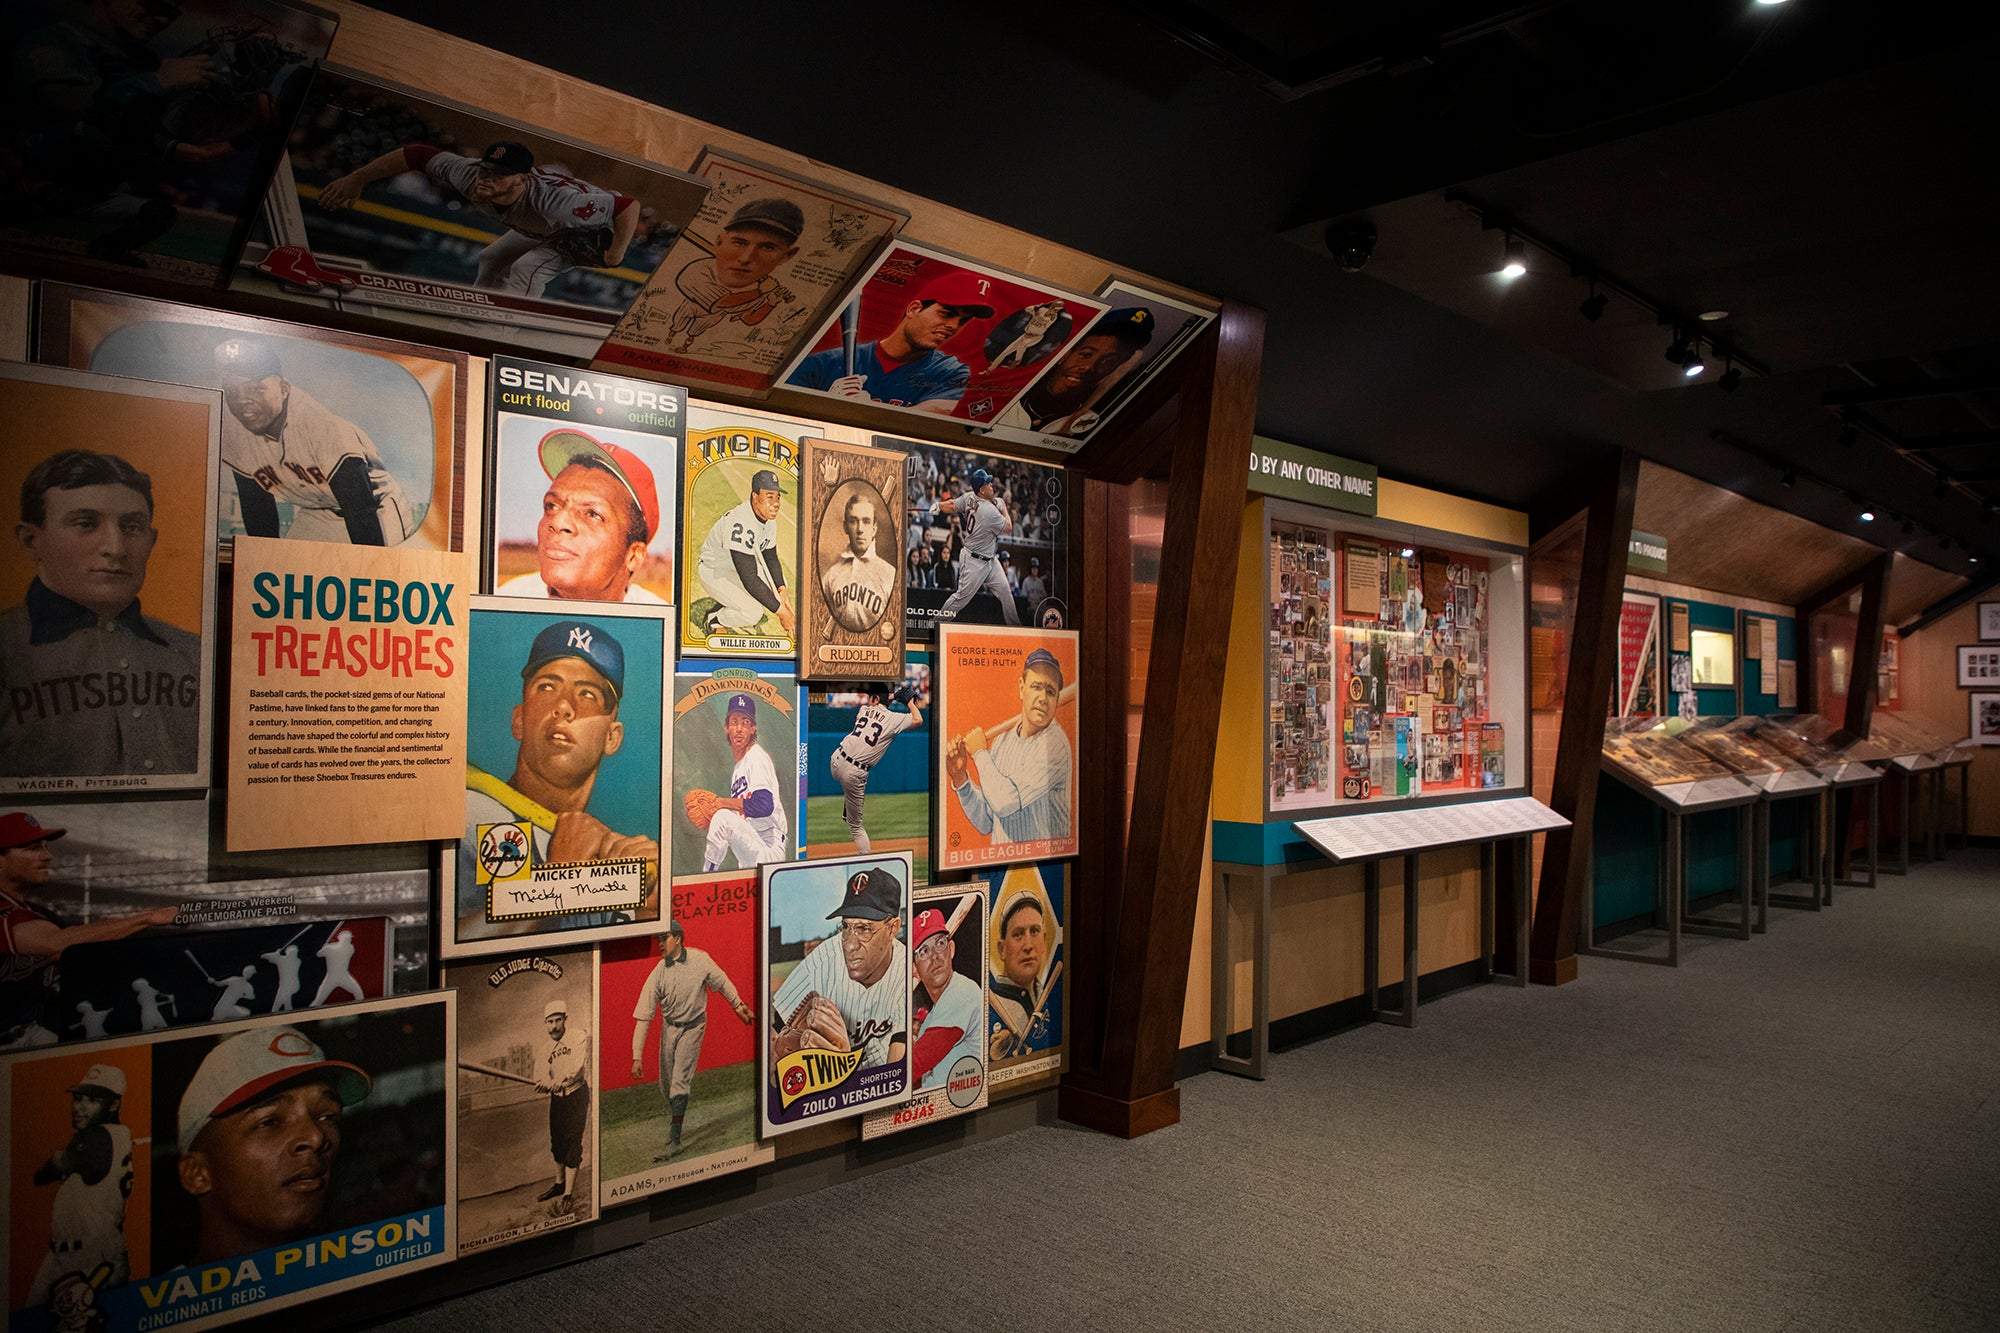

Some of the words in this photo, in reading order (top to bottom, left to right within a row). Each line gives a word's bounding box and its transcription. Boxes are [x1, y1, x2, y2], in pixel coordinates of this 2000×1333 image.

[359, 274, 416, 293] CRAIG
[419, 283, 495, 305] KIMBREL
[364, 291, 427, 308] BOSTON
[430, 300, 458, 313] RED
[460, 306, 491, 318] SOX
[621, 350, 663, 365] FRANK
[499, 366, 678, 413] SENATORS
[502, 391, 532, 407] curt
[535, 394, 570, 413] flood
[628, 411, 676, 429] outfield
[697, 433, 799, 470] TIGER
[1262, 455, 1278, 475] BY
[1281, 460, 1304, 481] ANY
[1306, 466, 1342, 490] OTHER
[1343, 475, 1373, 497] NAME
[730, 523, 756, 549] 23
[252, 571, 455, 626] SHOEBOX
[832, 582, 882, 615] ORONTO
[906, 607, 925, 616] OLO
[926, 609, 957, 618] COLON
[567, 627, 593, 653] NY
[719, 639, 747, 648] WILLIE
[749, 640, 780, 649] HORTON
[251, 625, 455, 678] TREASURES
[830, 649, 880, 662] RUDOLPH
[951, 646, 987, 655] GEORGE
[989, 648, 1023, 656] HERMAN
[958, 657, 990, 667] (BABE)
[992, 658, 1017, 667] RUTH
[716, 669, 754, 679] DONRUSS
[10, 670, 200, 725] PITTSBURG
[250, 690, 283, 698] Baseball
[285, 690, 309, 699] cards,
[310, 690, 323, 698] the
[325, 691, 371, 700] pocket-sized
[416, 691, 446, 699] National
[696, 680, 743, 698] DIAMOND
[743, 681, 773, 698] KINGS
[249, 704, 284, 712] Pastime,
[285, 704, 303, 712] have
[305, 704, 328, 712] linked
[330, 704, 346, 712] fans
[357, 704, 369, 712] the
[392, 704, 402, 712] for
[865, 709, 885, 723] NOMO
[256, 719, 289, 728] century.
[291, 718, 334, 727] Innovation,
[335, 718, 383, 727] competition,
[399, 718, 433, 727] changing
[852, 717, 883, 747] 23
[248, 732, 285, 741] demands
[287, 732, 305, 740] have
[307, 732, 334, 741] shaped
[336, 732, 348, 740] the
[395, 731, 424, 740] complex
[425, 731, 450, 739] history
[248, 747, 257, 755] of
[258, 747, 291, 755] baseball
[293, 746, 316, 754] cards.
[340, 745, 352, 753] the
[354, 745, 385, 753] financial
[401, 744, 443, 752] sentimental
[248, 761, 269, 769] value
[271, 761, 279, 769] of
[281, 760, 302, 768] cards
[304, 760, 318, 768] has
[380, 760, 402, 768] years,
[403, 758, 415, 766] the
[17, 779, 79, 790] WAGNER,
[85, 778, 147, 787] PITTSBURG
[247, 775, 278, 785] passion
[280, 775, 292, 783] for
[293, 774, 315, 782] these
[317, 773, 349, 782] Shoebox
[480, 840, 527, 865] Yankees
[950, 849, 973, 863] BIG
[980, 842, 1032, 860] LEAGUE
[1036, 838, 1073, 848] CHEWING
[1045, 844, 1065, 853] GUM
[534, 868, 583, 882] MICKEY
[589, 864, 638, 878] MANTLE
[210, 899, 247, 911] Players
[250, 895, 293, 907] Weekend
[509, 887, 563, 909] Mickey
[570, 881, 628, 896] Mantle
[672, 891, 695, 907] er
[706, 881, 758, 903] Jack
[175, 908, 264, 924] COMMEMORATIVE
[266, 905, 296, 916] PATCH
[672, 901, 748, 920] PLAYERS
[490, 967, 508, 985] OLD
[507, 958, 532, 975] JUDGE
[533, 957, 562, 979] Cigarettes
[802, 1054, 855, 1087] TWINS
[860, 1068, 902, 1085] SHORTSTOP
[1016, 1061, 1050, 1075] WASHINGTON
[949, 1075, 981, 1093] PHILLIES
[802, 1096, 836, 1116] ZOILO
[841, 1080, 902, 1105] VERSALLES
[893, 1103, 935, 1125] ROJAS
[610, 1178, 656, 1198] ADAMS,
[659, 1167, 704, 1184] PITTSBURGH
[711, 1157, 748, 1171] NATIONALS
[460, 1230, 521, 1250] RICHARDSON,
[523, 1226, 531, 1234] L.
[544, 1214, 574, 1228] Detroits
[139, 1259, 261, 1309] VADA
[275, 1214, 431, 1275] PINSON
[375, 1241, 431, 1268] OUTFIELD
[138, 1297, 223, 1333] CINCINNATI
[231, 1285, 267, 1309] REDS
